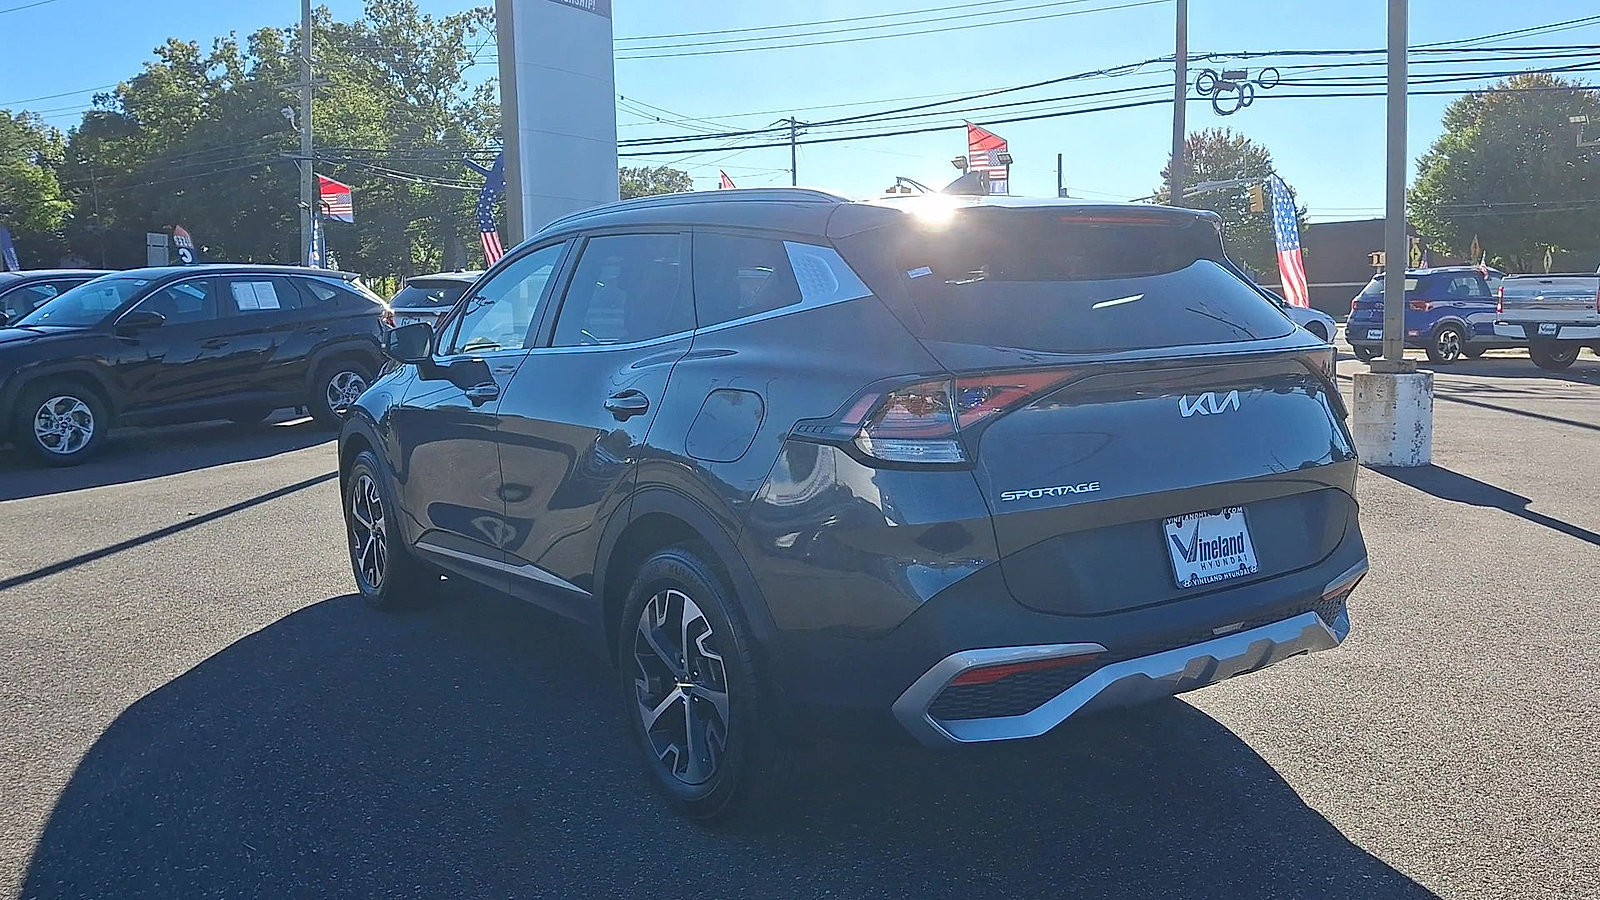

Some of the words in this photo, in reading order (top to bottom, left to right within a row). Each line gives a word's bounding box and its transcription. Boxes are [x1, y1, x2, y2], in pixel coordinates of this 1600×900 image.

[1001, 481, 1101, 501] SPORTAGE
[1170, 520, 1245, 563] Vineland
[1200, 554, 1248, 571] HYUNDAI
[1192, 575, 1222, 587] VINELAND
[1224, 567, 1251, 580] HYUNDAI
